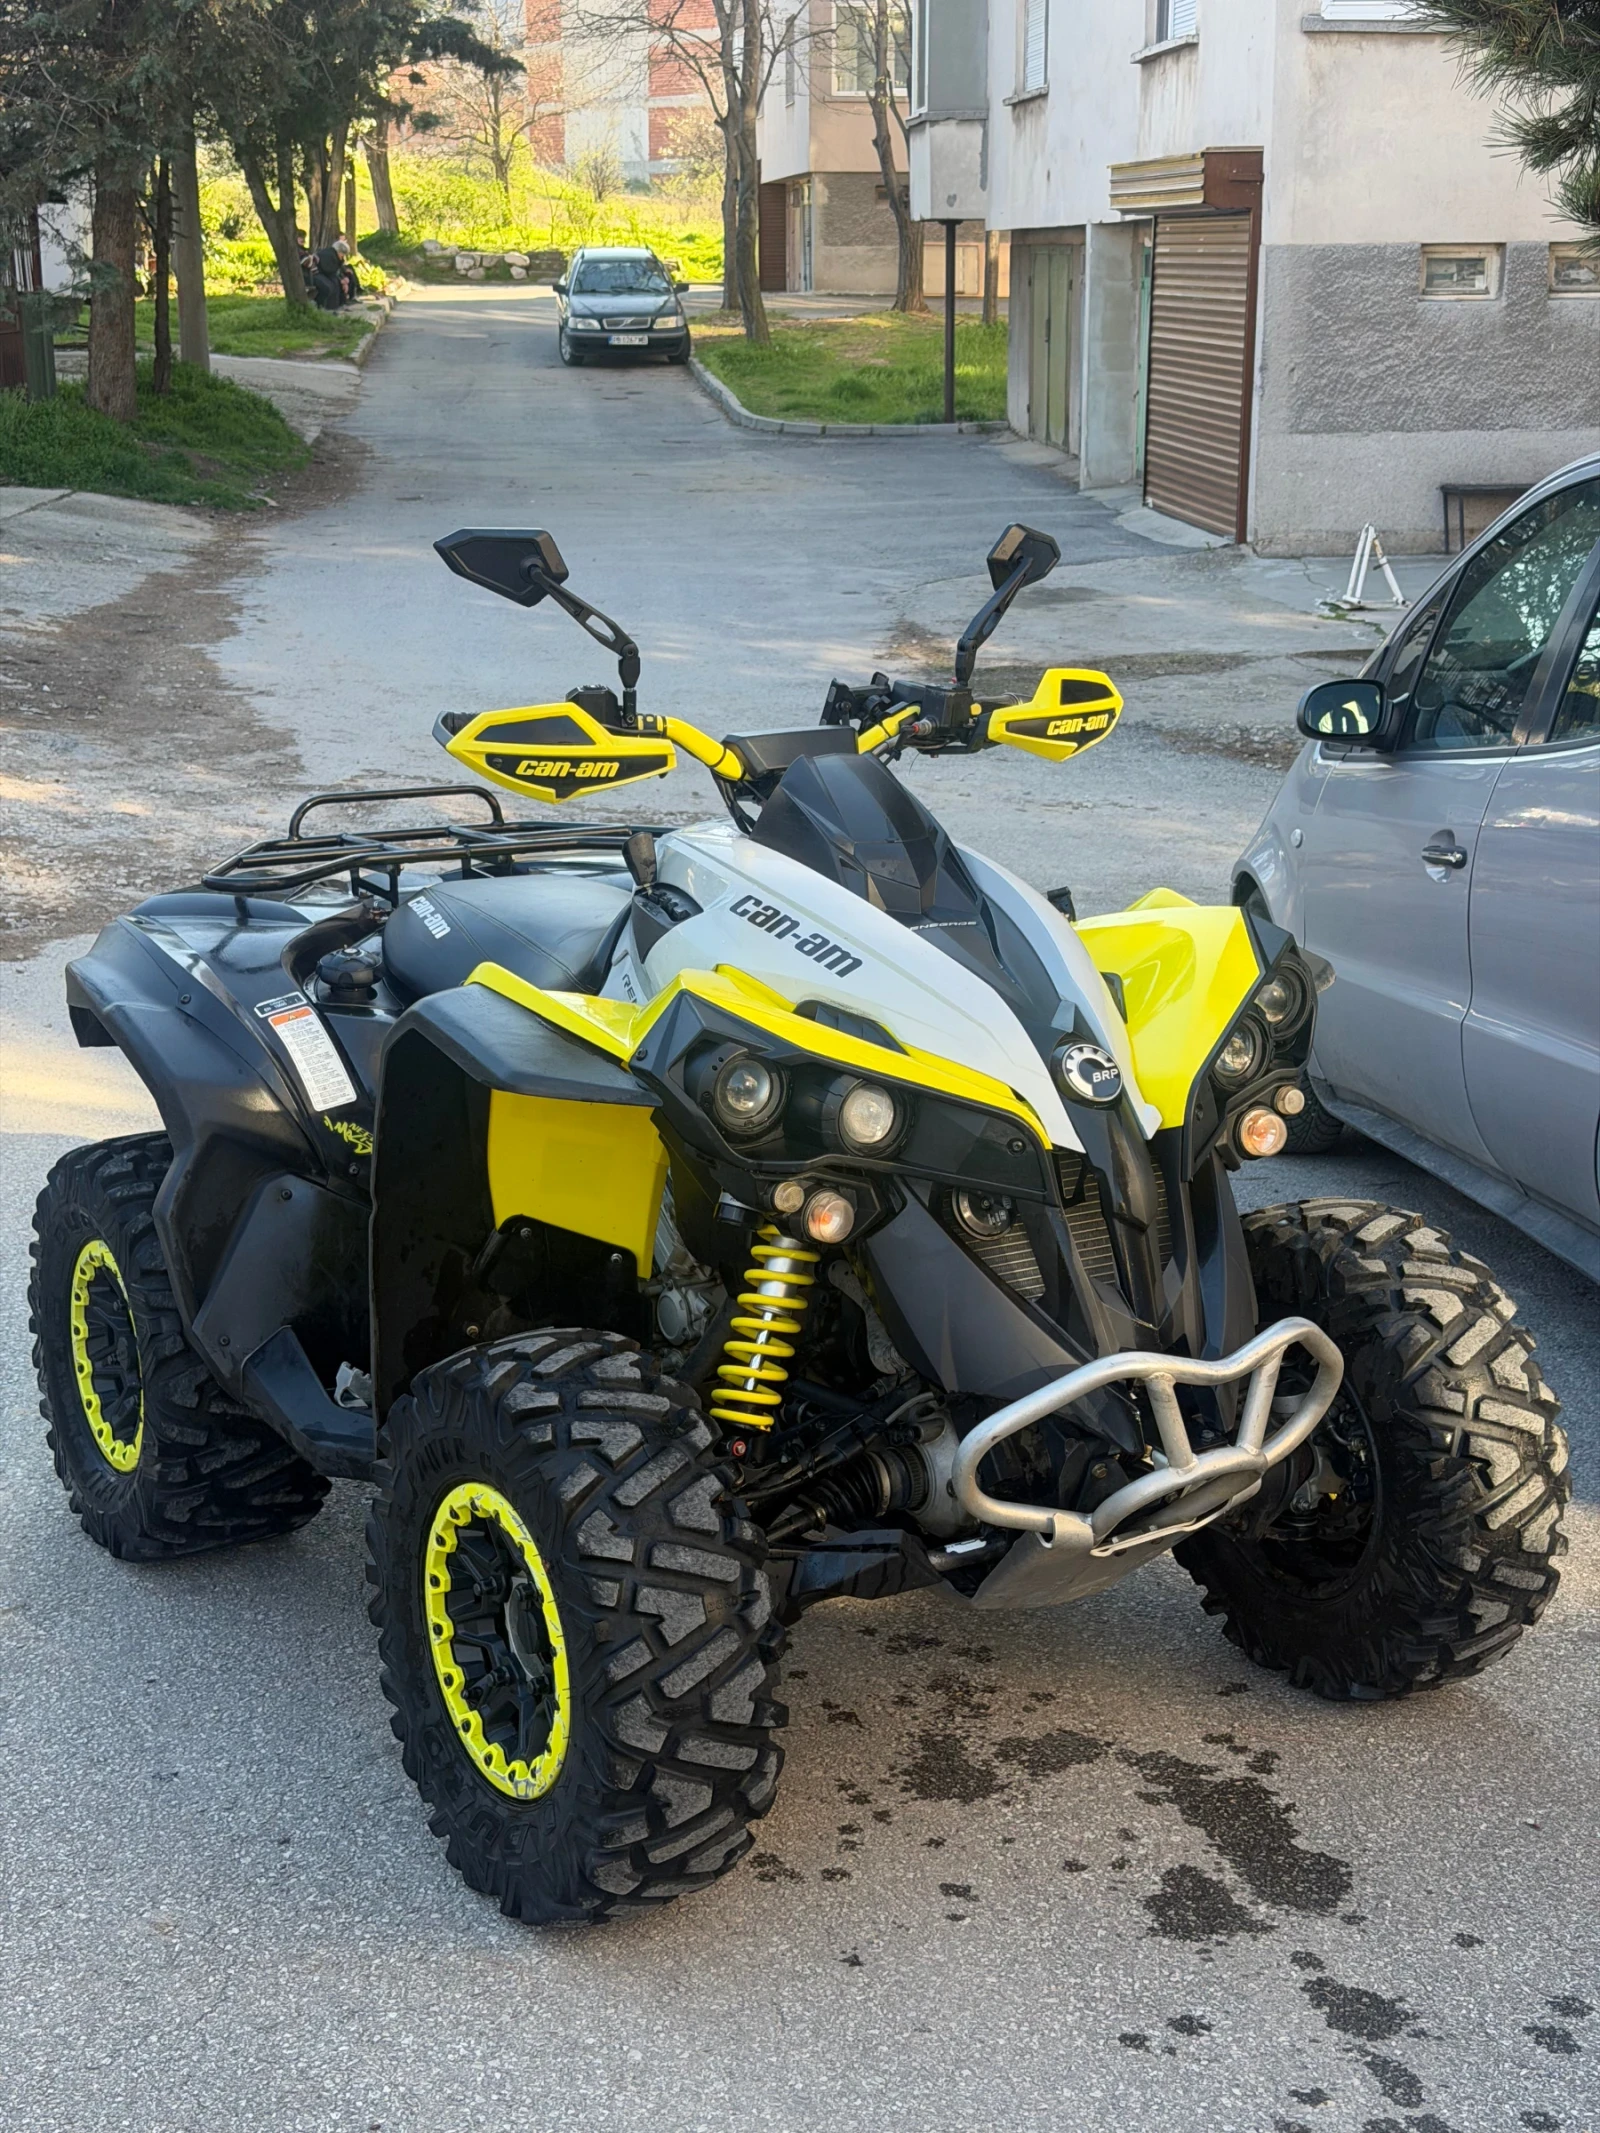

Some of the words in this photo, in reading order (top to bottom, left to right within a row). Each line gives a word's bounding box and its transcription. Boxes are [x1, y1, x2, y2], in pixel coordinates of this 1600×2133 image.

[1046, 713, 1109, 736] can-am
[515, 760, 620, 778] can-am
[407, 895, 451, 939] can-am
[729, 894, 863, 978] can-am
[1092, 1068, 1119, 1083] BRP
